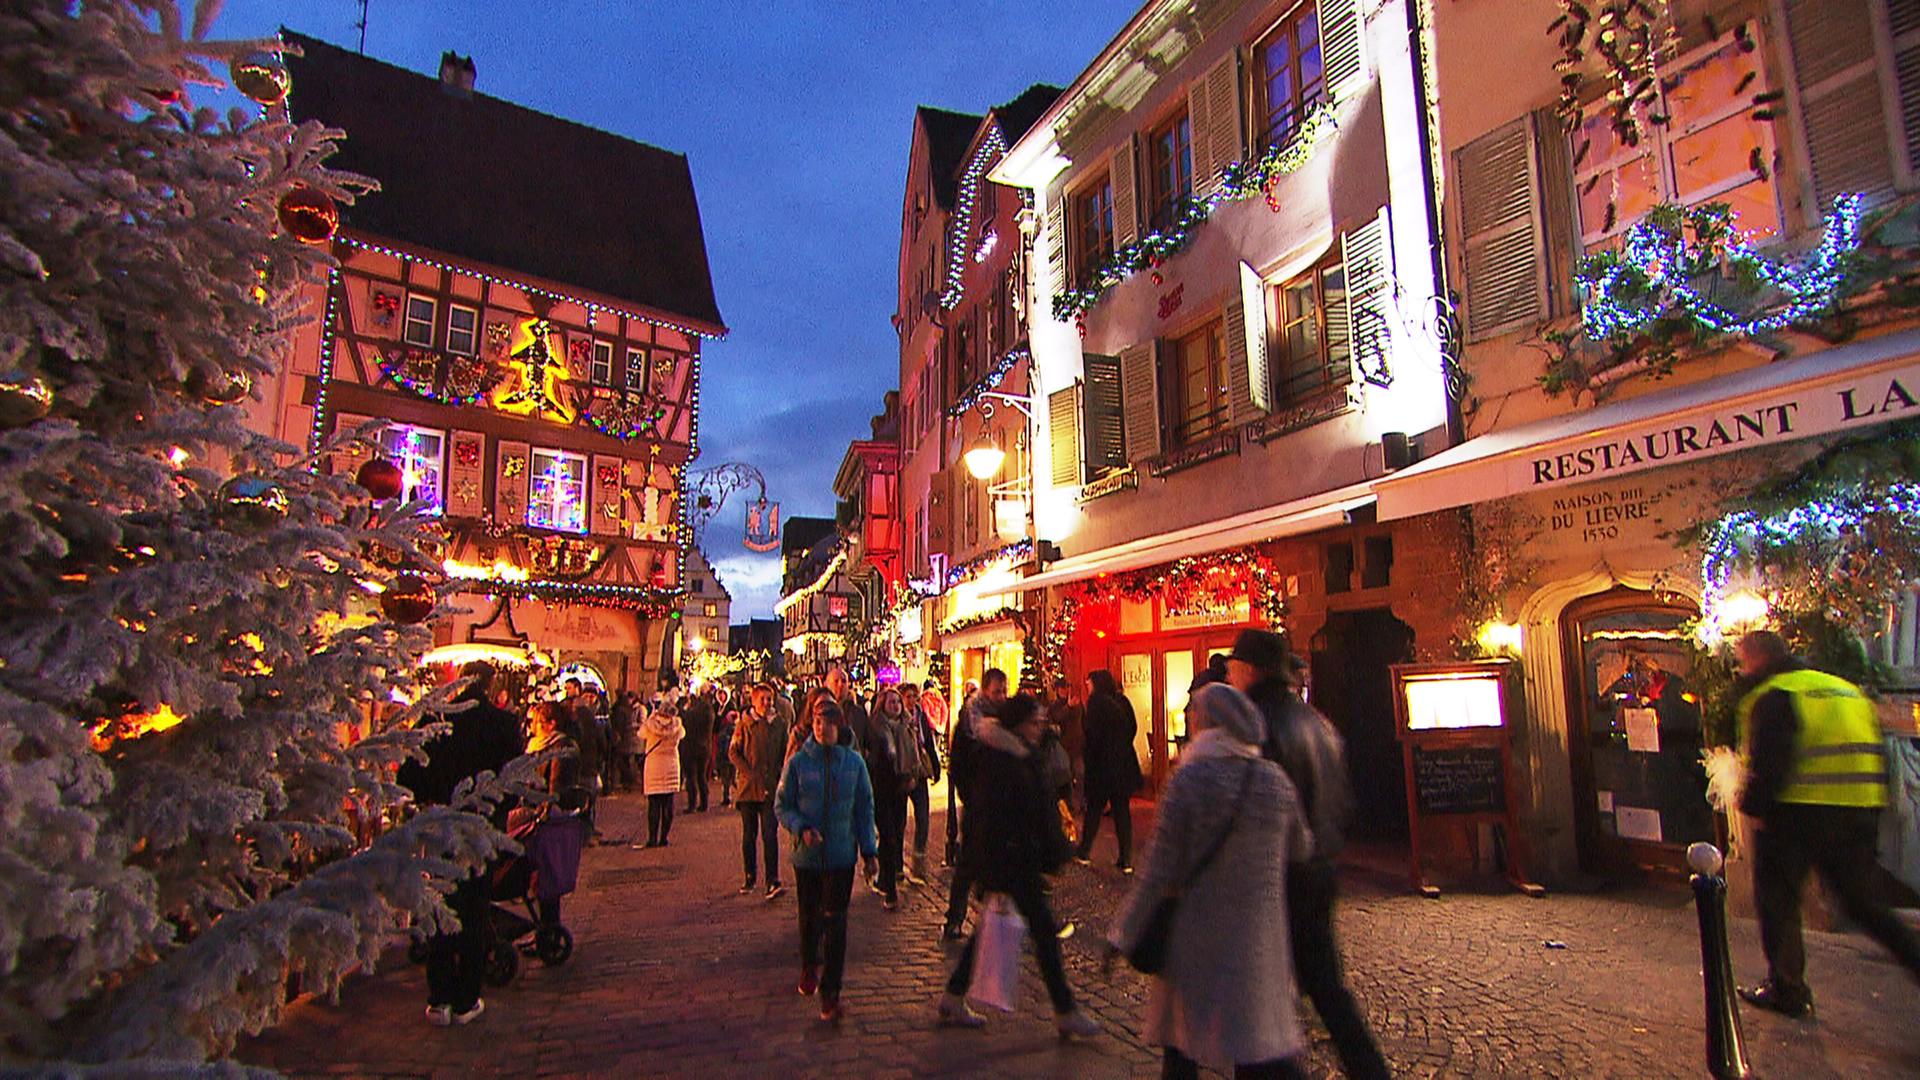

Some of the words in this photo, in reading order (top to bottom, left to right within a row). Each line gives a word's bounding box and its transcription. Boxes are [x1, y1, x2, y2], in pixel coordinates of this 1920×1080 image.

[1531, 402, 1798, 484] RESTAURANT
[1837, 378, 1919, 421] LA
[1553, 490, 1613, 511] MAISON
[1552, 512, 1574, 530] DU
[1583, 525, 1618, 542] 1530
